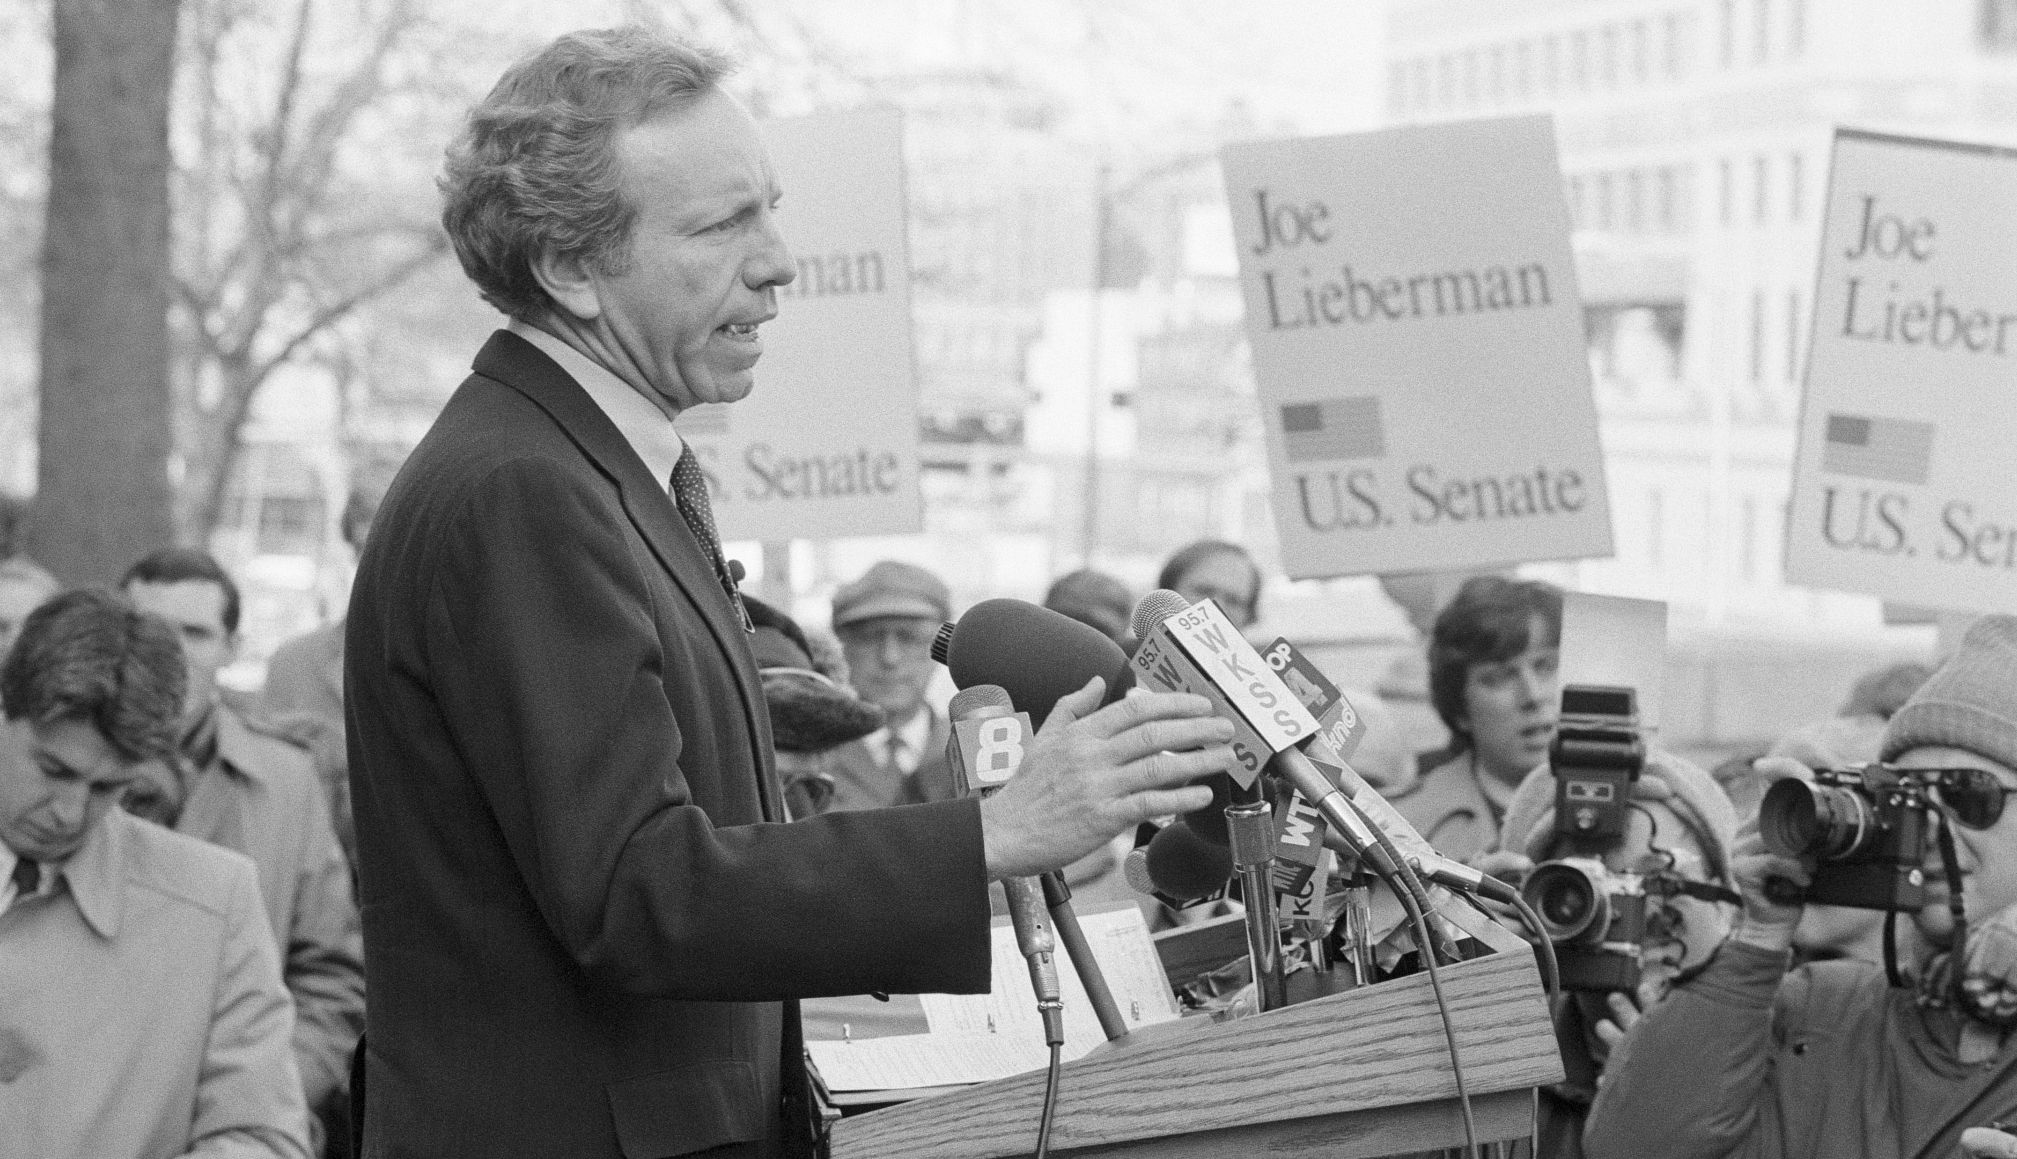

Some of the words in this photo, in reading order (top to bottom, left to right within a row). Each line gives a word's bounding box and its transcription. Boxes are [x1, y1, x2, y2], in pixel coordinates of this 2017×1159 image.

[1252, 189, 1333, 256] Joe
[1844, 193, 1936, 262] Joe
[1263, 262, 1552, 331] Lieberman
[743, 441, 900, 498] Senate
[1294, 467, 1395, 533] U.S.
[1405, 463, 1584, 526] Senate
[1821, 486, 1918, 558] U.S.
[1178, 605, 1210, 631] 95.7
[1138, 637, 1162, 671] 95.7
[1283, 666, 1329, 709] 4
[976, 716, 1024, 783] 8
